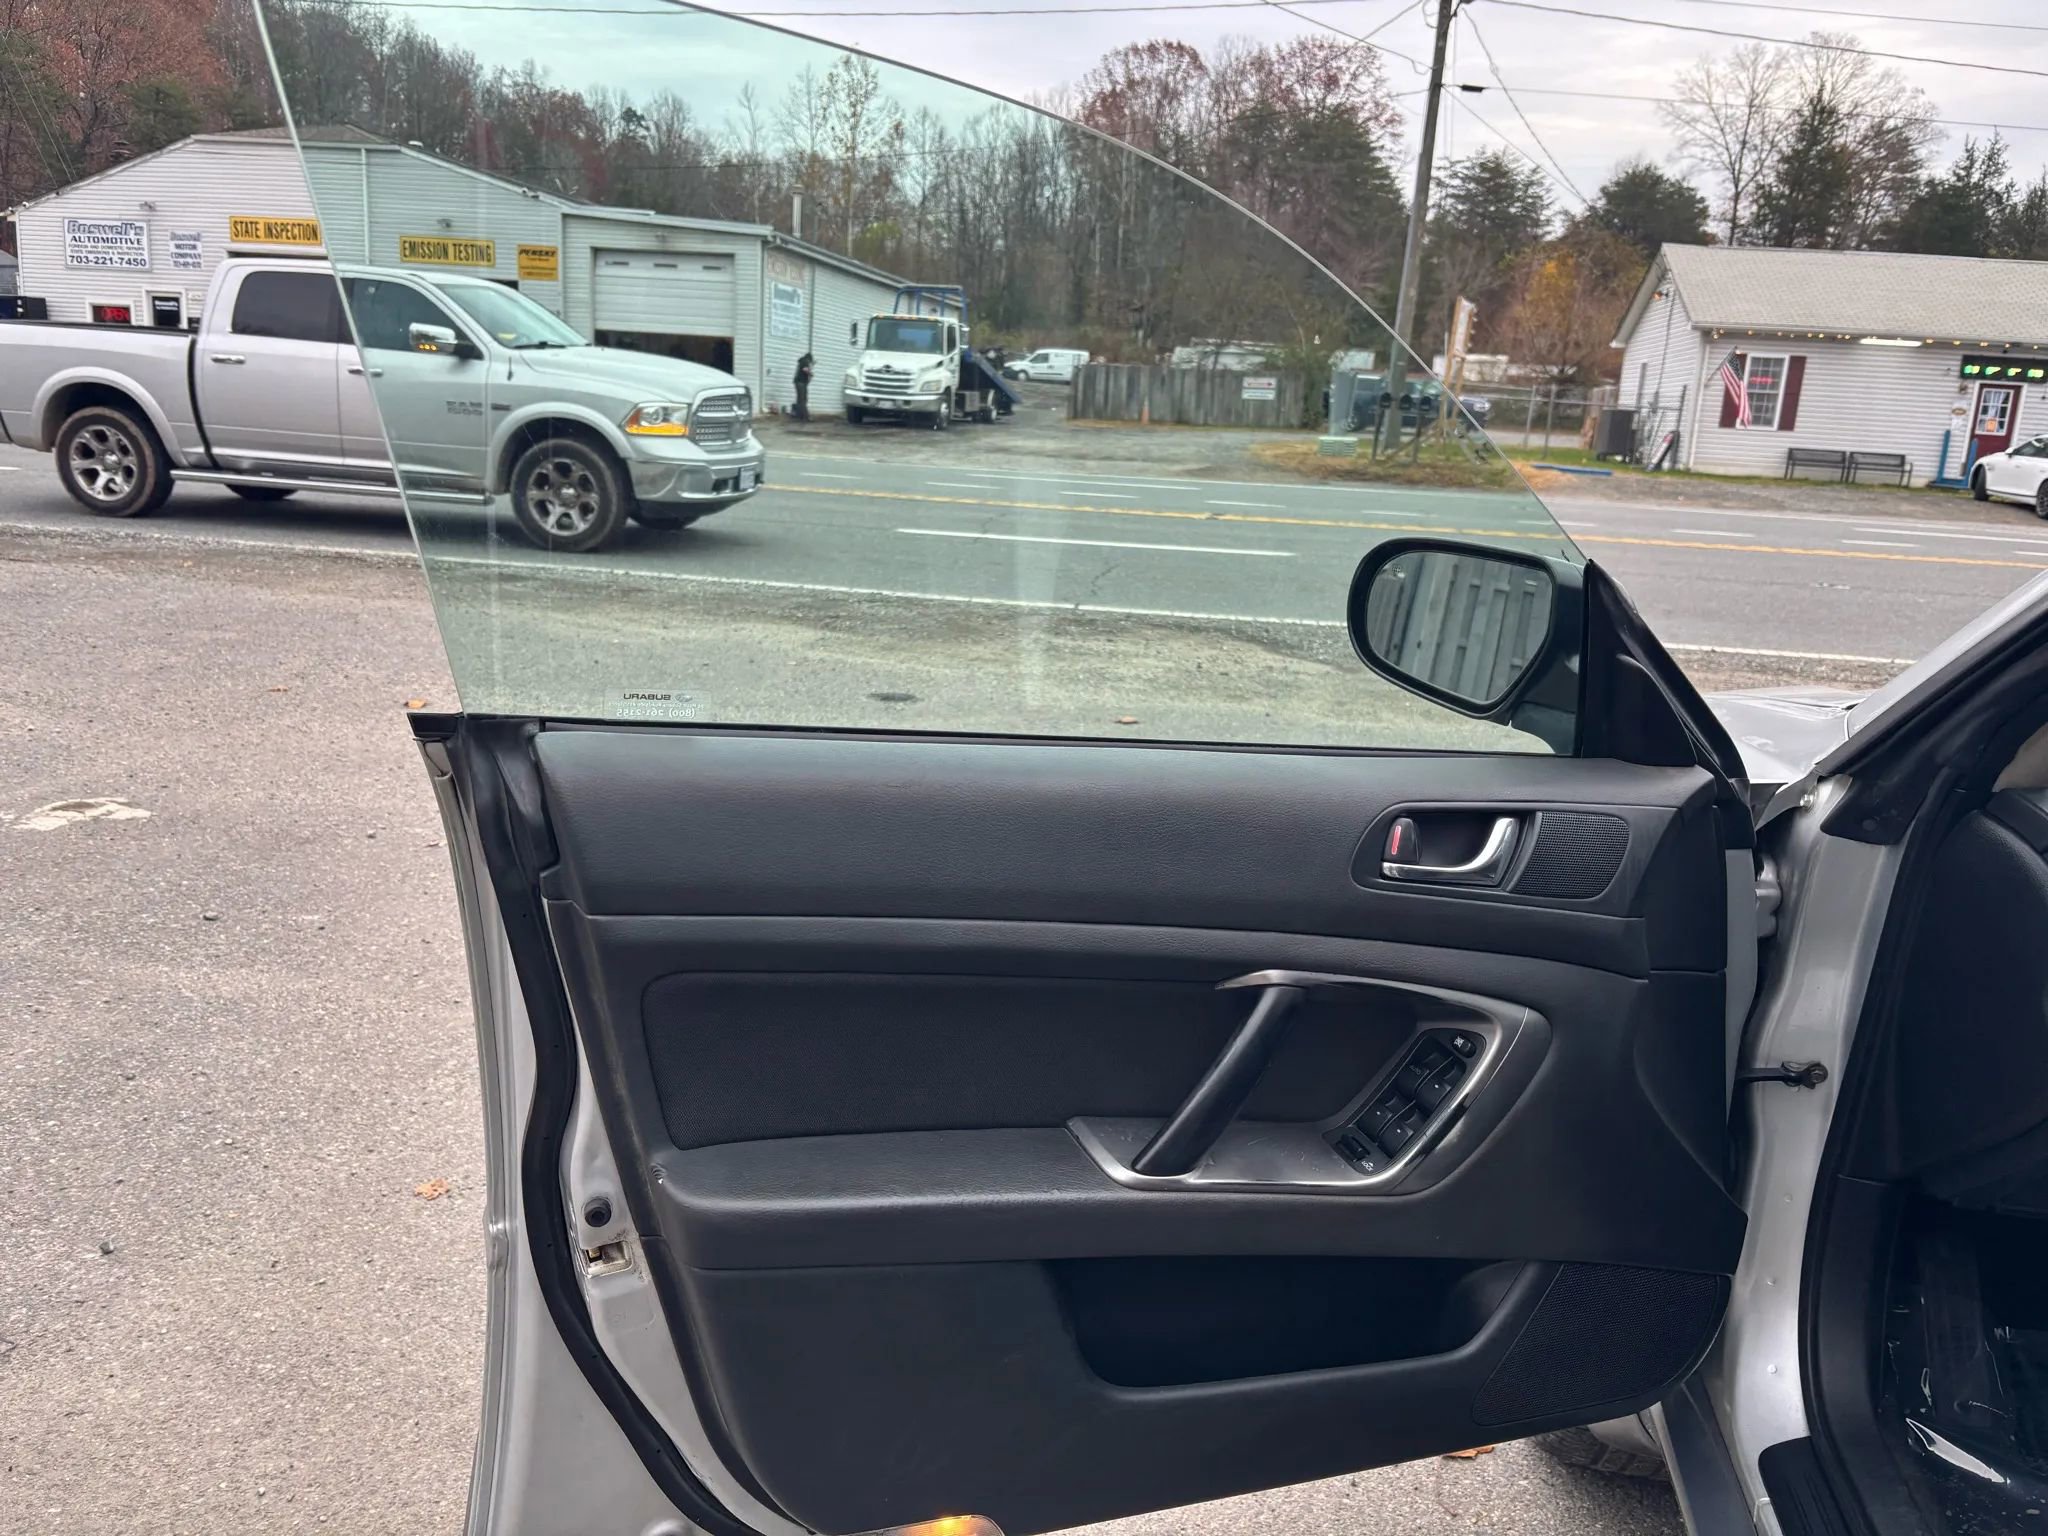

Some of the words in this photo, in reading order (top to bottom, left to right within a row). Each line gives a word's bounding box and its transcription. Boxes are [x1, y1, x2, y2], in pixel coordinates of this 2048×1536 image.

[232, 220, 260, 239] STATE
[263, 221, 319, 241] INSPECTION
[70, 235, 143, 246] AUTOMOTIVE
[402, 240, 449, 260] EMISSION
[452, 243, 492, 263] TESTING
[68, 255, 147, 267] 703-221-7450
